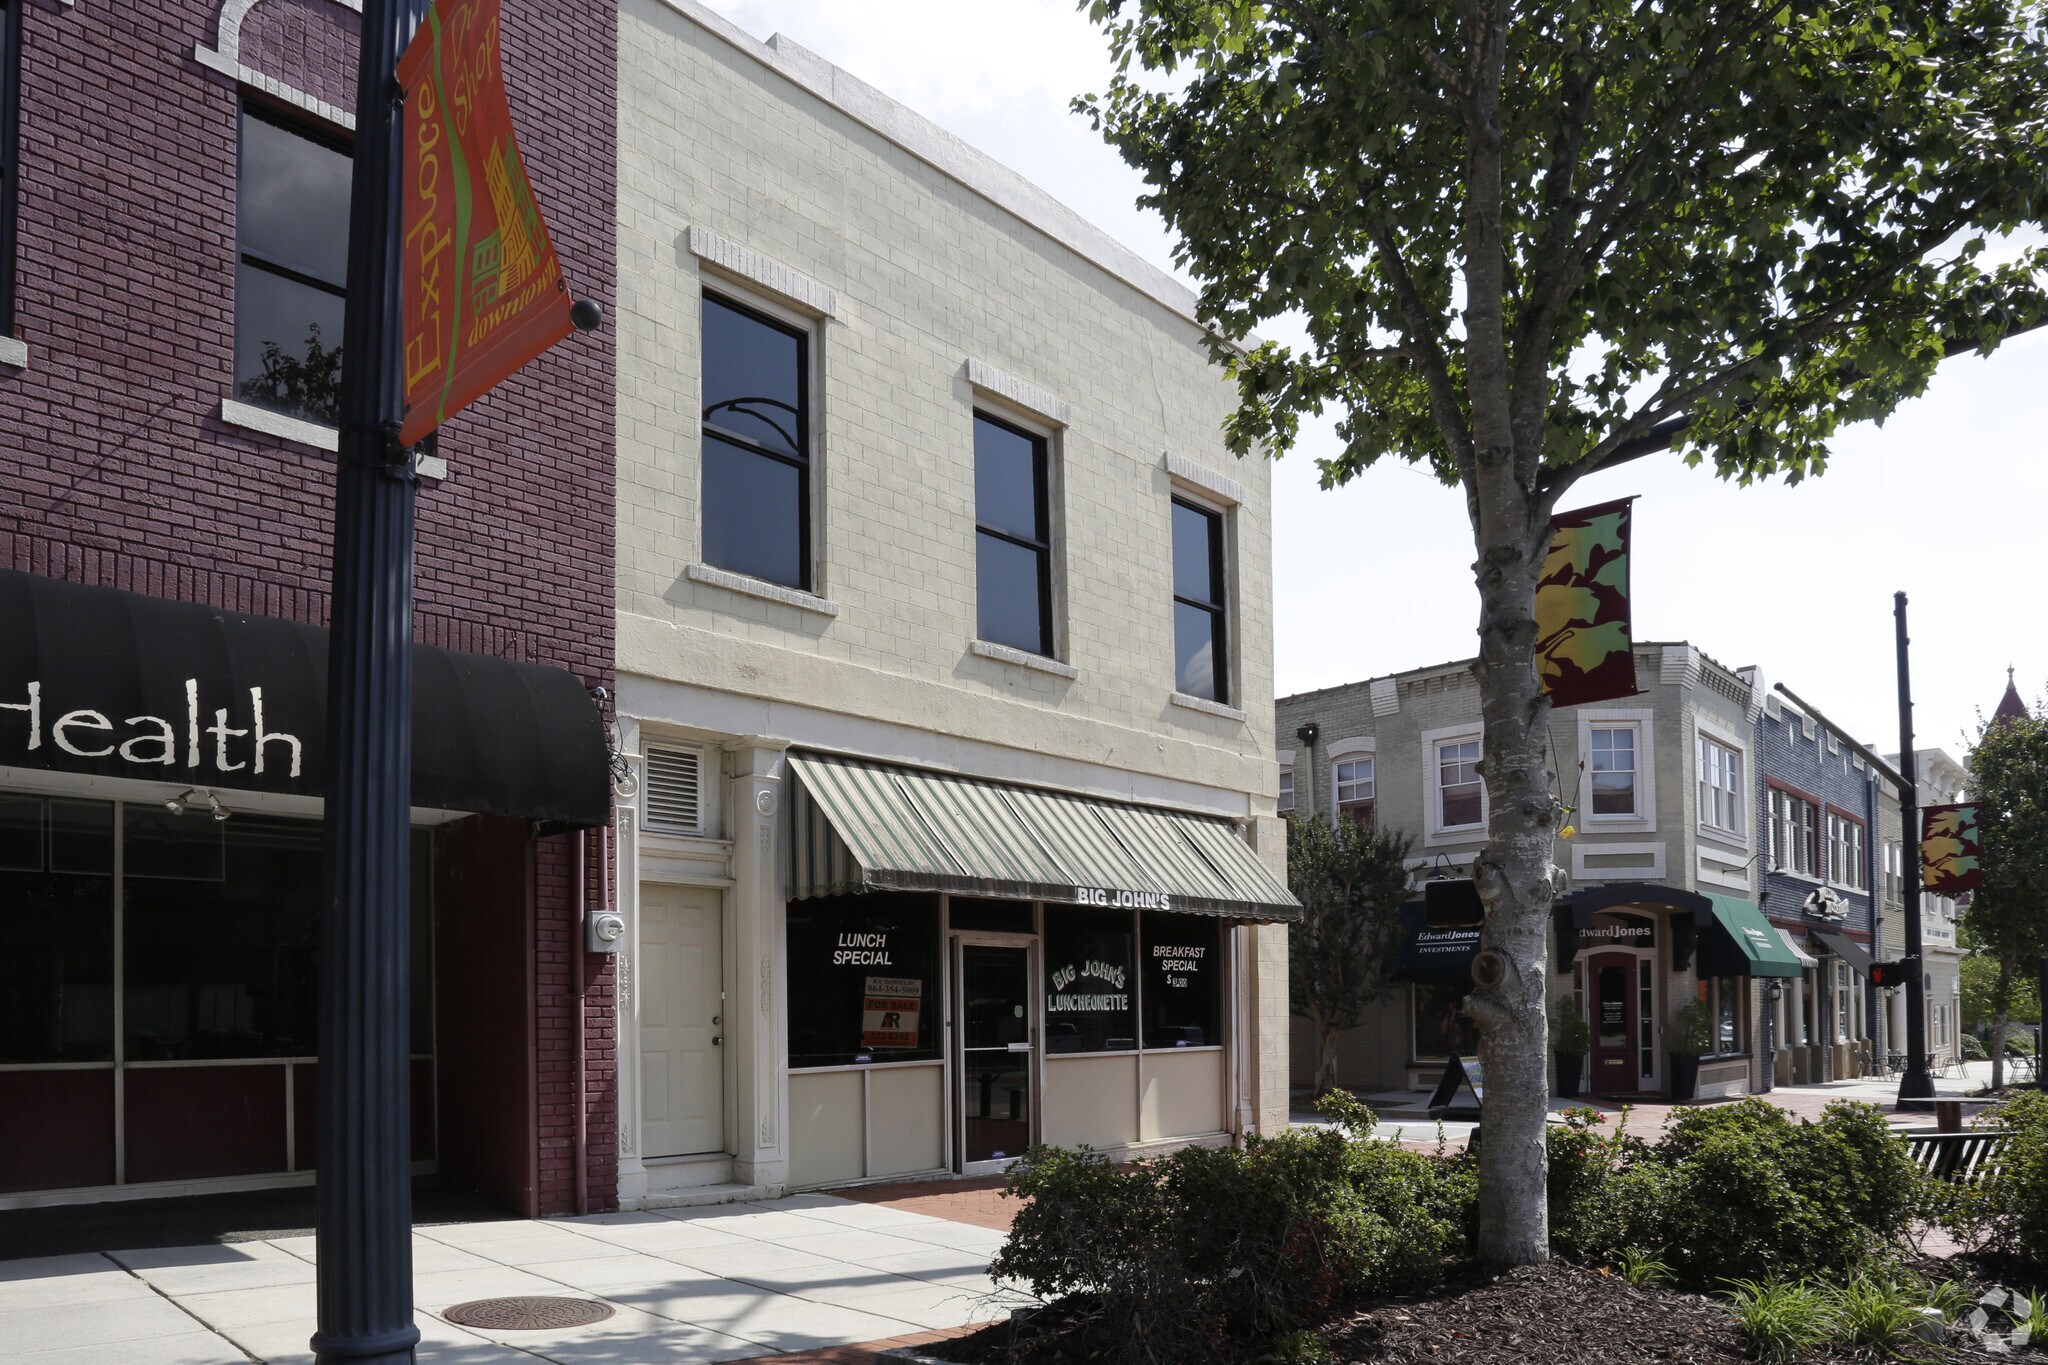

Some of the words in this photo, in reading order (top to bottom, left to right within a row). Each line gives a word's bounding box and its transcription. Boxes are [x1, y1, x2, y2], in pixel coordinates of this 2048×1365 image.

[455, 15, 496, 137] Shop
[406, 74, 451, 396] Explore
[468, 259, 556, 348] downtown
[0, 678, 302, 778] Health
[1077, 887, 1108, 906] BIG
[1112, 890, 1170, 910] JOHN'S
[838, 933, 886, 948] LUNCH
[1153, 945, 1205, 958] BREAKFAST
[1419, 945, 1471, 954] INVESTMENTS
[833, 951, 892, 965] SPECIAL
[1161, 960, 1198, 972] SPECIAL
[1052, 963, 1076, 991] BIG
[1081, 959, 1126, 990] JOHN'S
[867, 984, 919, 994] 864-354-5009
[868, 1000, 888, 1009] FOR
[891, 1001, 915, 1010] SALE
[1048, 994, 1128, 1012] LUNCHEONETTE
